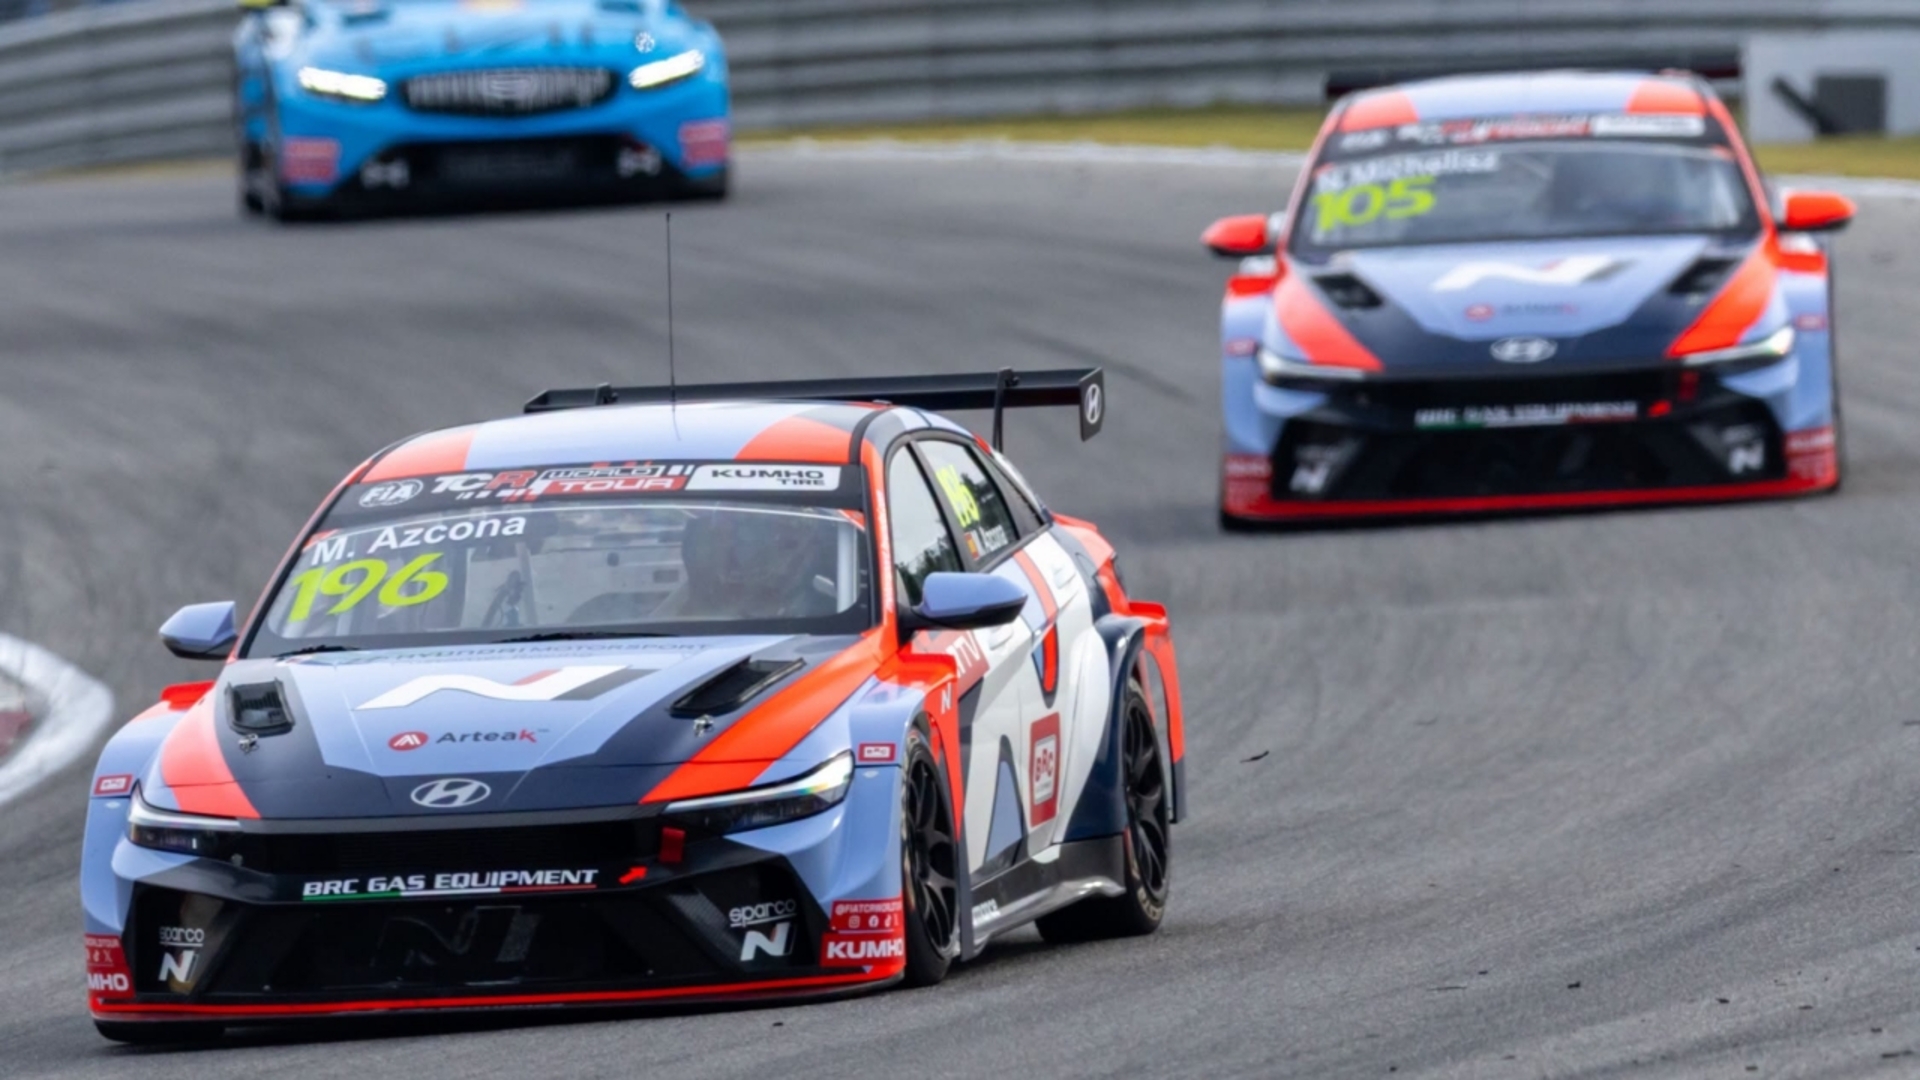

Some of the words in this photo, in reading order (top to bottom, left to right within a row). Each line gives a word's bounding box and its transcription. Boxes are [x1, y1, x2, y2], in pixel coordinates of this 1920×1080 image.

[1312, 174, 1438, 232] 105
[431, 470, 537, 494] TCR
[548, 464, 654, 478] WORLD
[711, 469, 824, 479] KUMHO
[362, 482, 420, 504] FIA
[558, 477, 675, 491] TOUR
[776, 478, 826, 487] TIRE
[311, 536, 355, 565] M.
[367, 516, 527, 554] Azcona
[287, 552, 448, 625] 196
[436, 729, 538, 744] Arteak
[303, 879, 359, 897] BRC
[367, 875, 426, 893] GAS
[434, 869, 599, 890] EQUIPMENT
[729, 899, 796, 926] sparco
[160, 927, 205, 943] sparco
